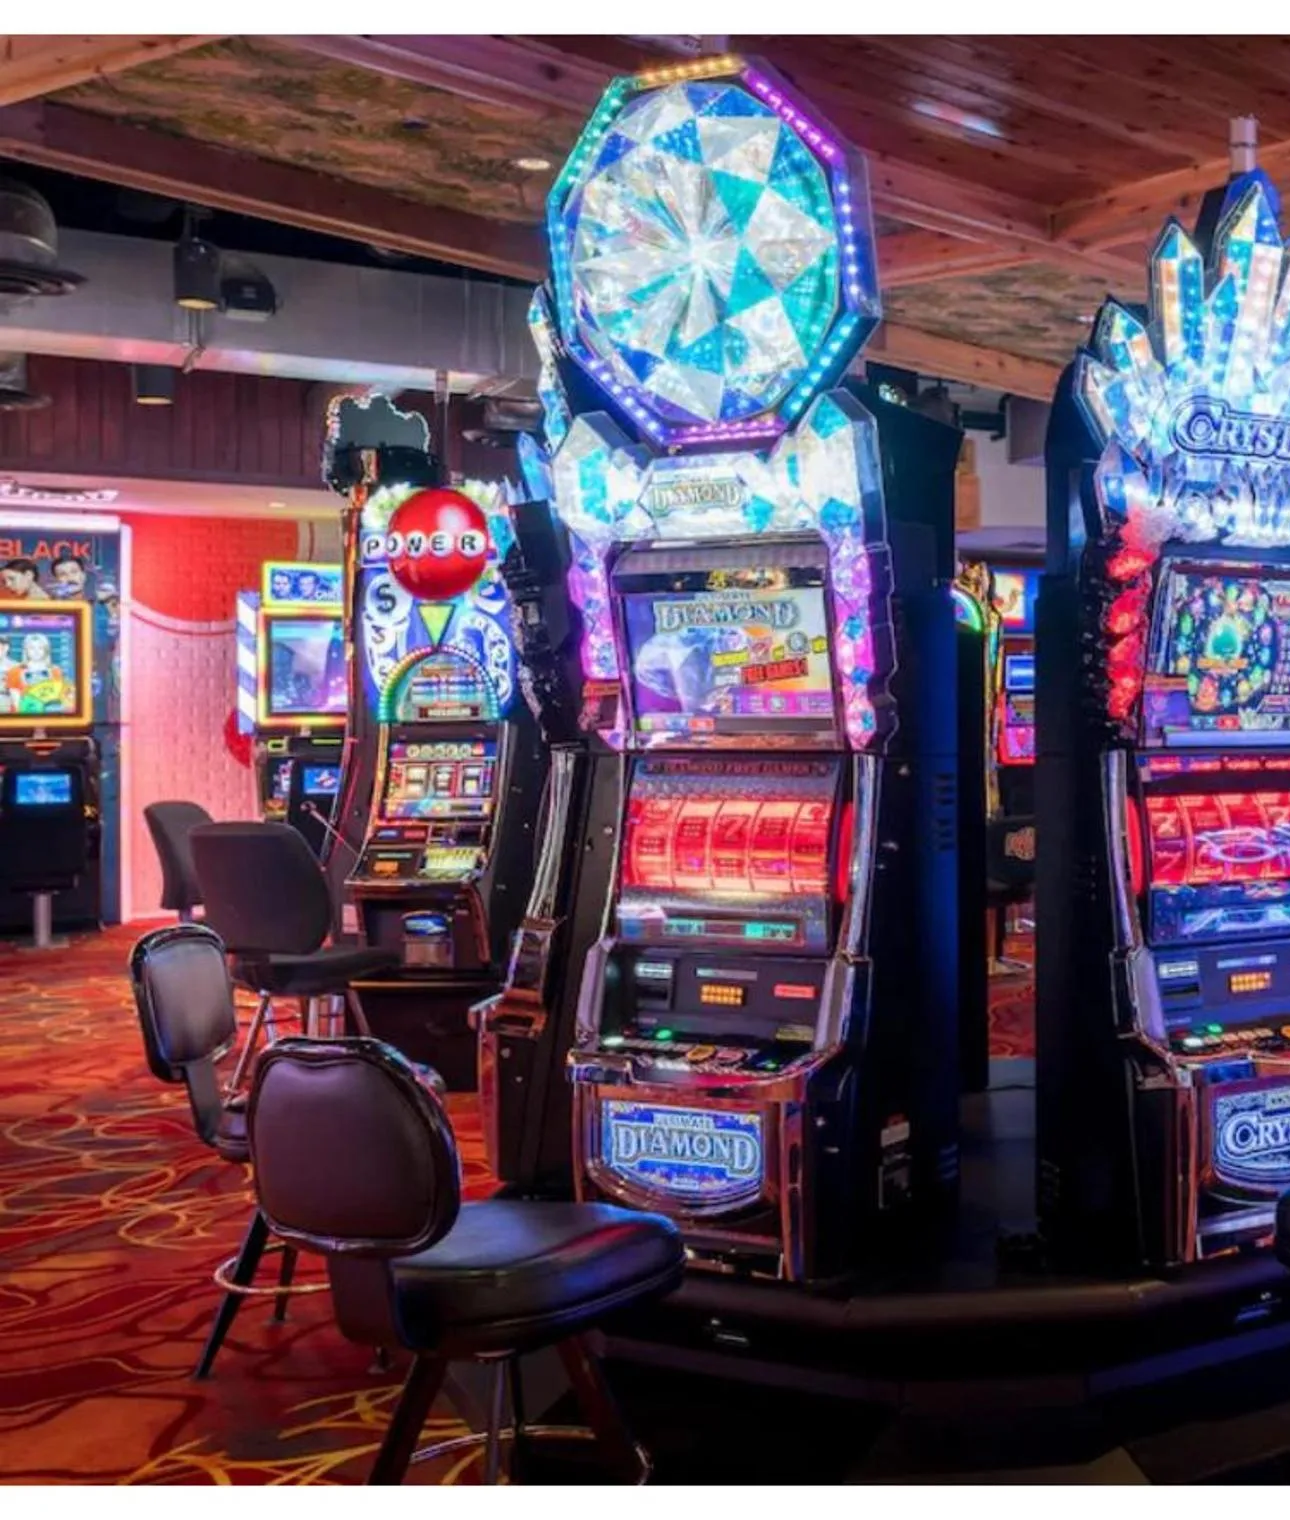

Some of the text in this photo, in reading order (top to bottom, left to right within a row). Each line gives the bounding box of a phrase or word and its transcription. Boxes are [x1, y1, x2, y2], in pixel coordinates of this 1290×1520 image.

[0, 539, 91, 560] BLACK
[367, 534, 477, 554] POWER
[618, 1126, 755, 1171] DIAMOND
